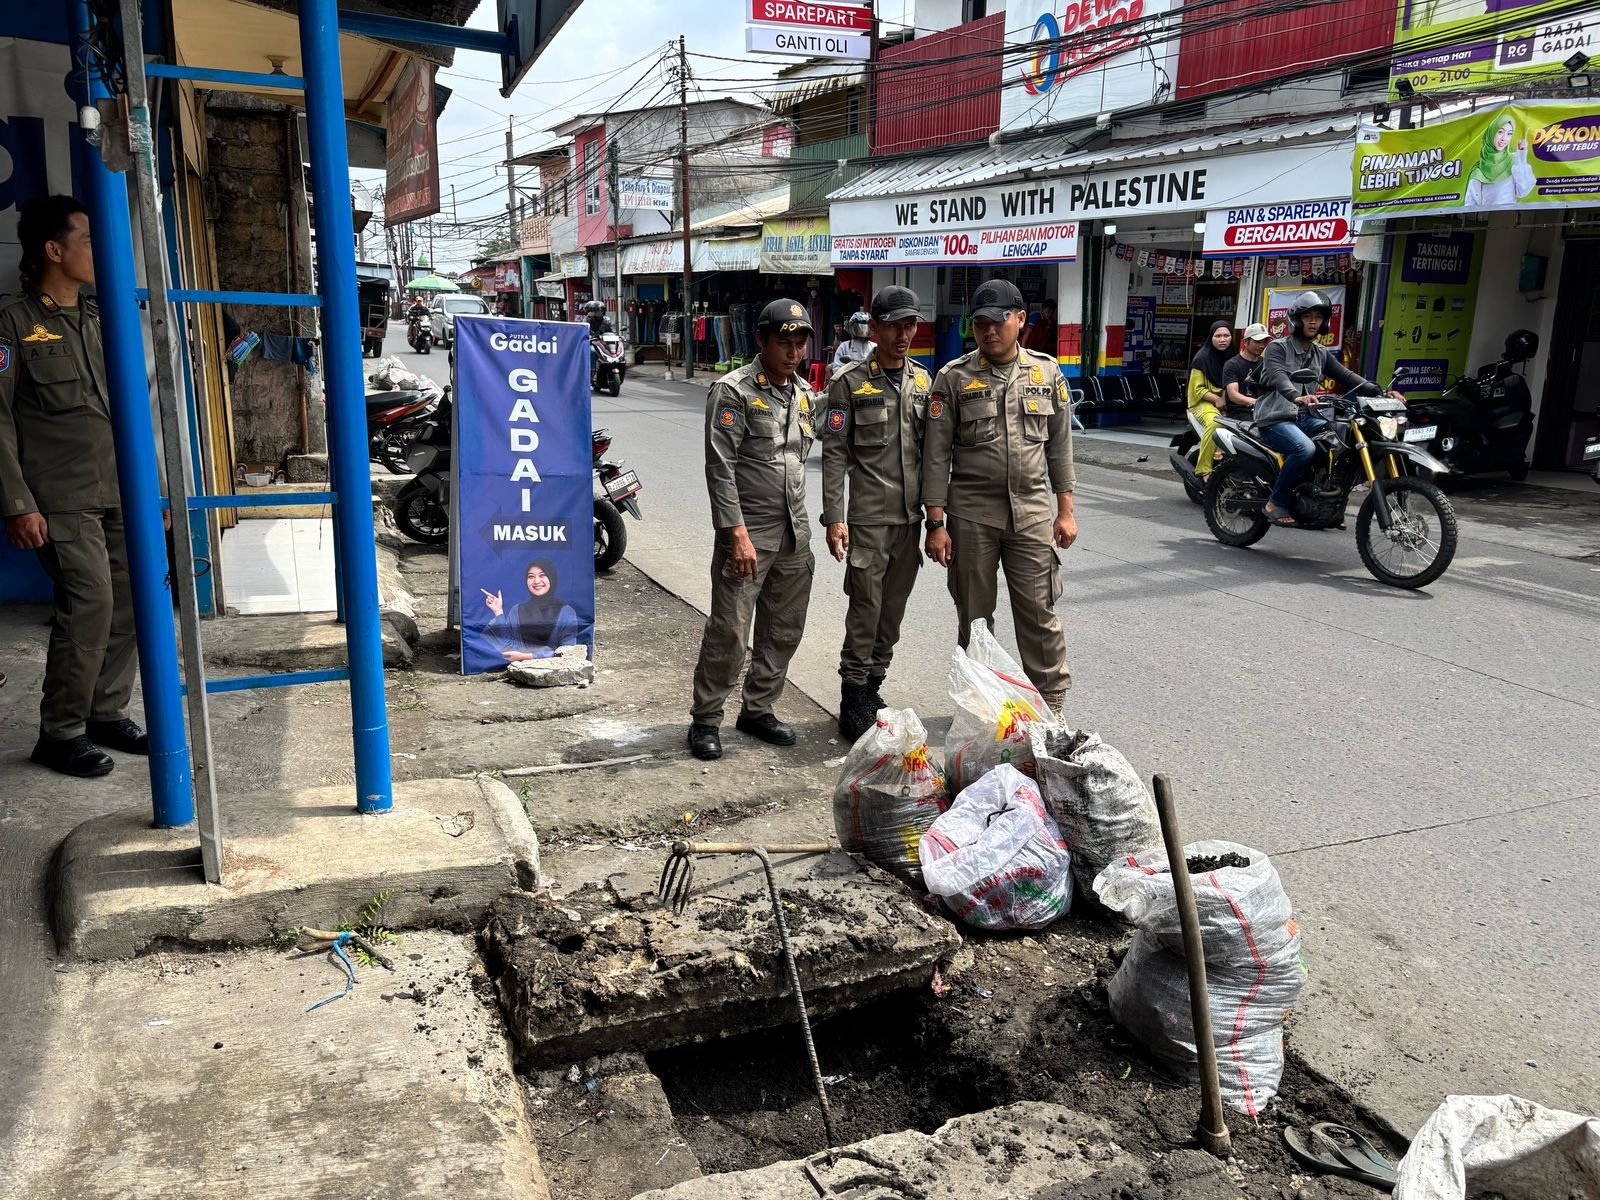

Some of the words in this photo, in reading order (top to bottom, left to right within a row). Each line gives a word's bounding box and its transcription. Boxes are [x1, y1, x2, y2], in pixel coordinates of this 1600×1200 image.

[764, 2, 857, 26] SPAREPART
[1064, 0, 1125, 34] DEW
[1543, 21, 1584, 39] RAJA
[775, 34, 821, 51] GANTI
[825, 39, 848, 53] OLI
[1507, 44, 1528, 58] RG
[1542, 34, 1592, 54] GADAI
[1421, 53, 1450, 65] Setiap
[1452, 50, 1472, 61] Hari
[1440, 67, 1471, 83] 21.00
[1546, 144, 1570, 152] TARIF
[1572, 142, 1598, 151] TEBUS
[1360, 148, 1442, 172] PINJAMAN
[1359, 172, 1401, 191] LEBIH
[1406, 160, 1461, 184] TINGGI
[895, 203, 919, 226] WE
[929, 196, 987, 224] STAND
[1001, 187, 1055, 217] WITH
[1070, 169, 1207, 212] PALESTINE
[1227, 208, 1255, 224] BAN
[1256, 208, 1265, 222] &
[1267, 200, 1350, 221] SPAREPART
[980, 229, 1017, 245] PILIHAN
[1017, 227, 1038, 242] BAN
[1038, 224, 1076, 240] MOTOR
[1234, 221, 1336, 244] BERGARANSI
[833, 238, 855, 250] GRATIS
[854, 237, 863, 249] ISI
[862, 236, 897, 249] NITROGEN
[899, 236, 925, 249] DISKON
[924, 235, 939, 247] BAN
[1002, 241, 1048, 258] LENGKAP
[1417, 242, 1459, 258] TAKSIRAN
[839, 249, 860, 261] TANPA
[860, 249, 889, 261] SYARAT
[1411, 257, 1457, 272] TERTINGGI
[1270, 309, 1288, 319] SERV
[490, 332, 558, 354] Gadai
[1418, 376, 1442, 385] KONDISI
[1025, 386, 1042, 396] POL
[1042, 387, 1051, 396] PP
[508, 368, 542, 512] GADAI
[493, 524, 567, 542] MASUK
